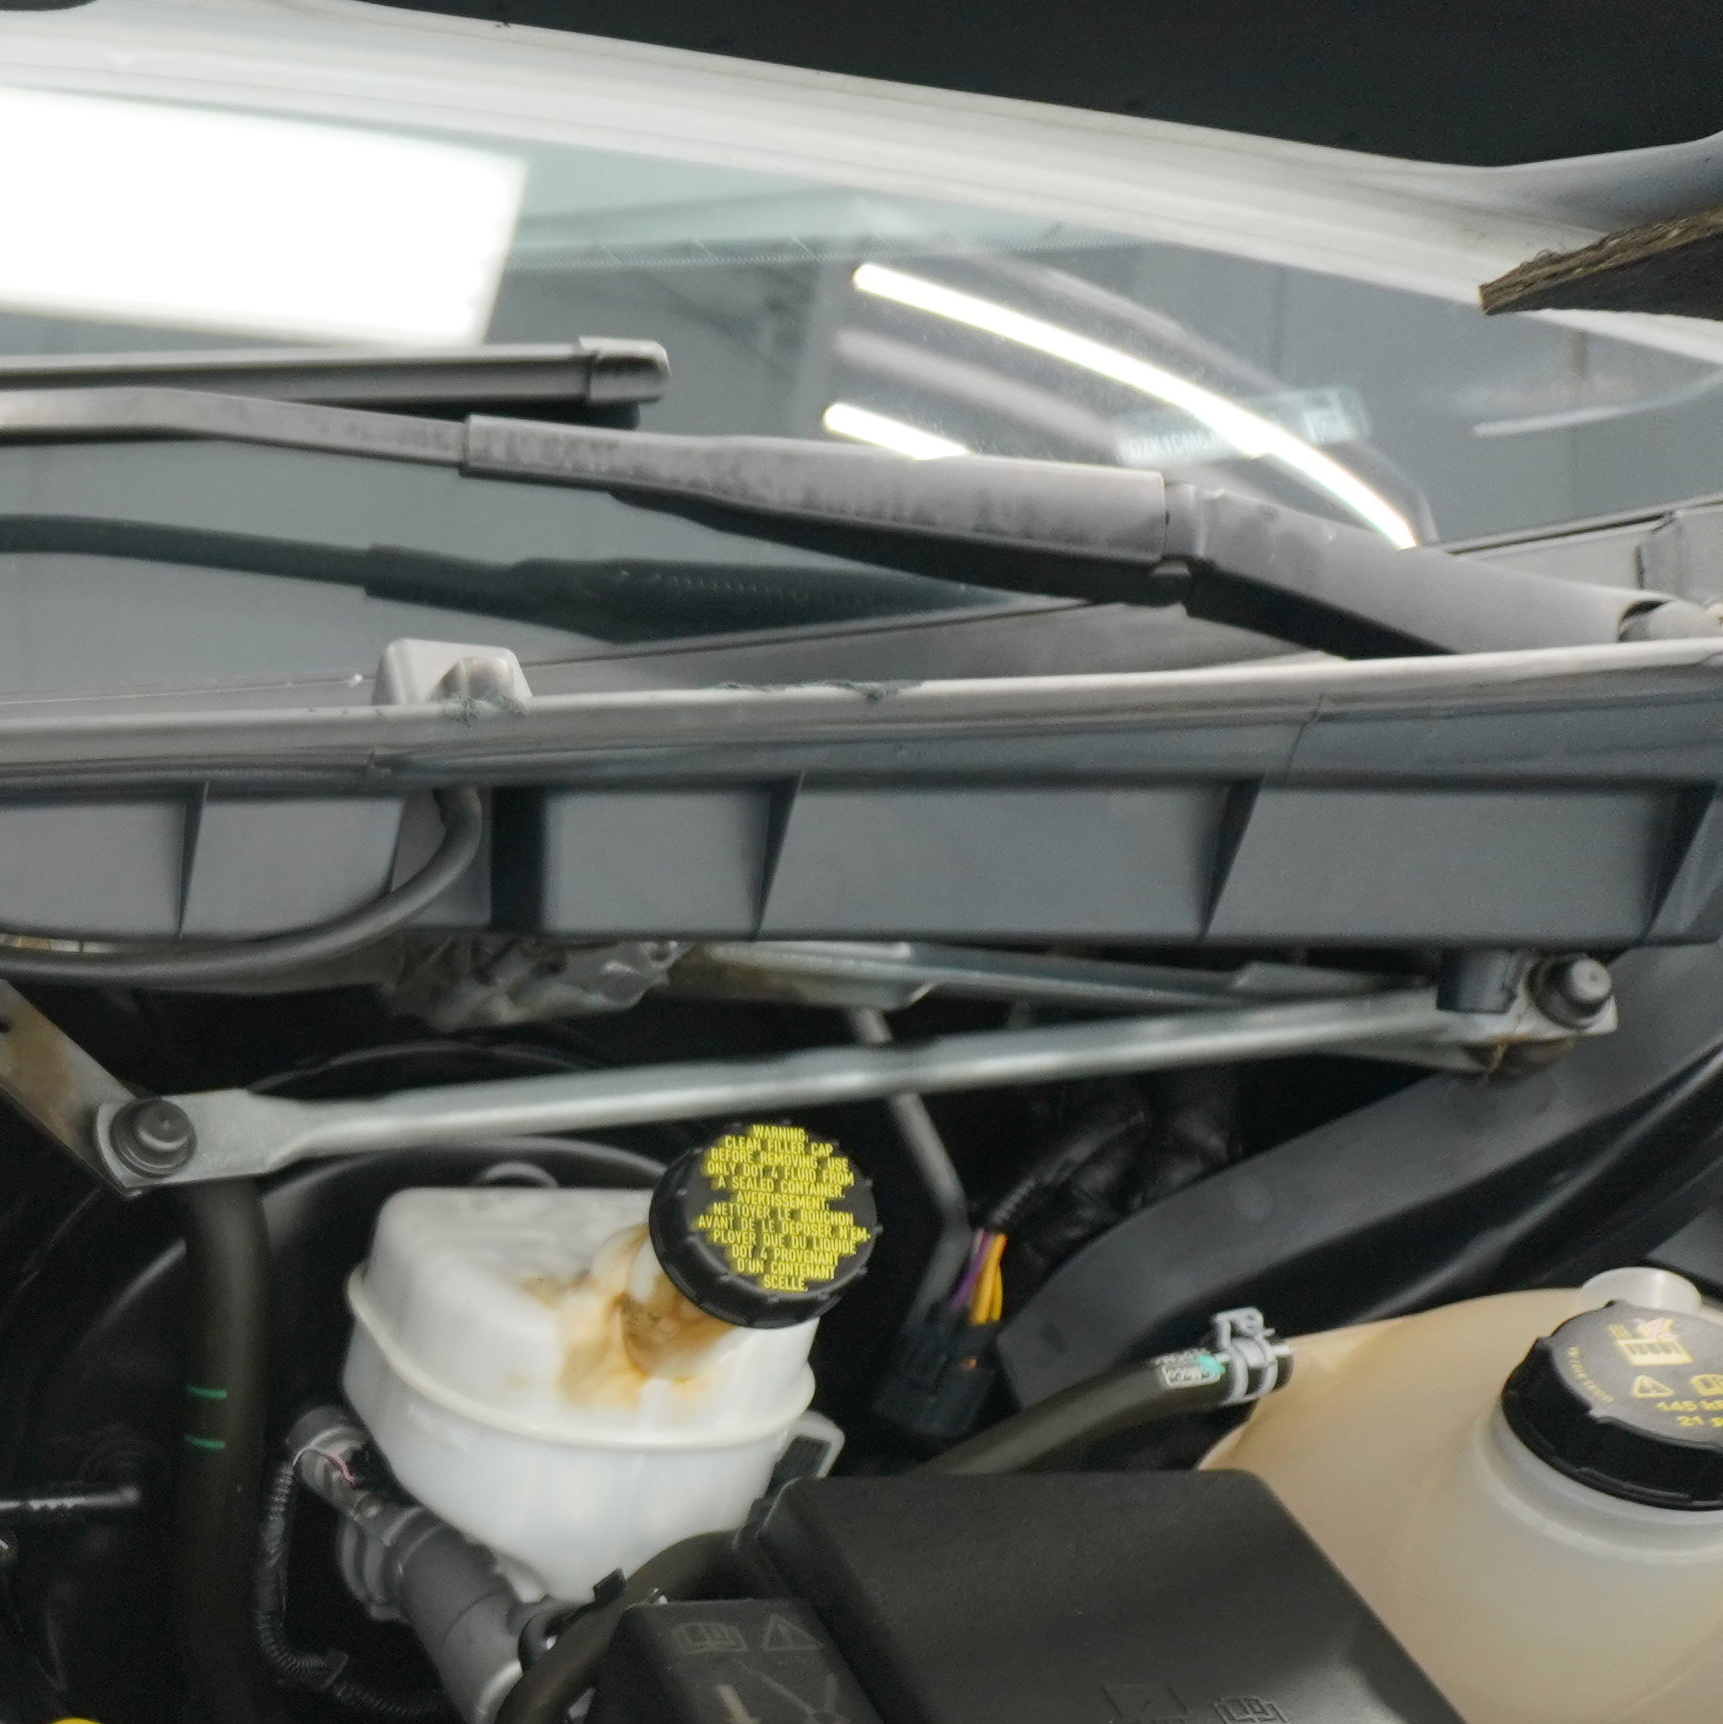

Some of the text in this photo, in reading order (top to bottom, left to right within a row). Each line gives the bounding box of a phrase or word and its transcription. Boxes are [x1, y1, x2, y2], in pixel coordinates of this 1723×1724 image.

[725, 1135, 834, 1157] CLEAN FILLER CAP
[711, 1148, 754, 1164] BEFORE
[827, 1157, 849, 1172] USE
[707, 1161, 854, 1187] ONLY DOT 4 FLUID FROM
[718, 1175, 726, 1188] A
[731, 1176, 774, 1192] SEALED
[698, 1214, 734, 1229] AVANT
[741, 1218, 755, 1231] DE
[762, 1219, 776, 1233] LE
[713, 1202, 854, 1226] NETTOYER LE BOUCHON
[713, 1230, 857, 1255] PLOYER QUE DU LIQUIDE
[732, 1244, 840, 1266] DOT 4 PROVENANT
[771, 1261, 835, 1279] CONTENANT
